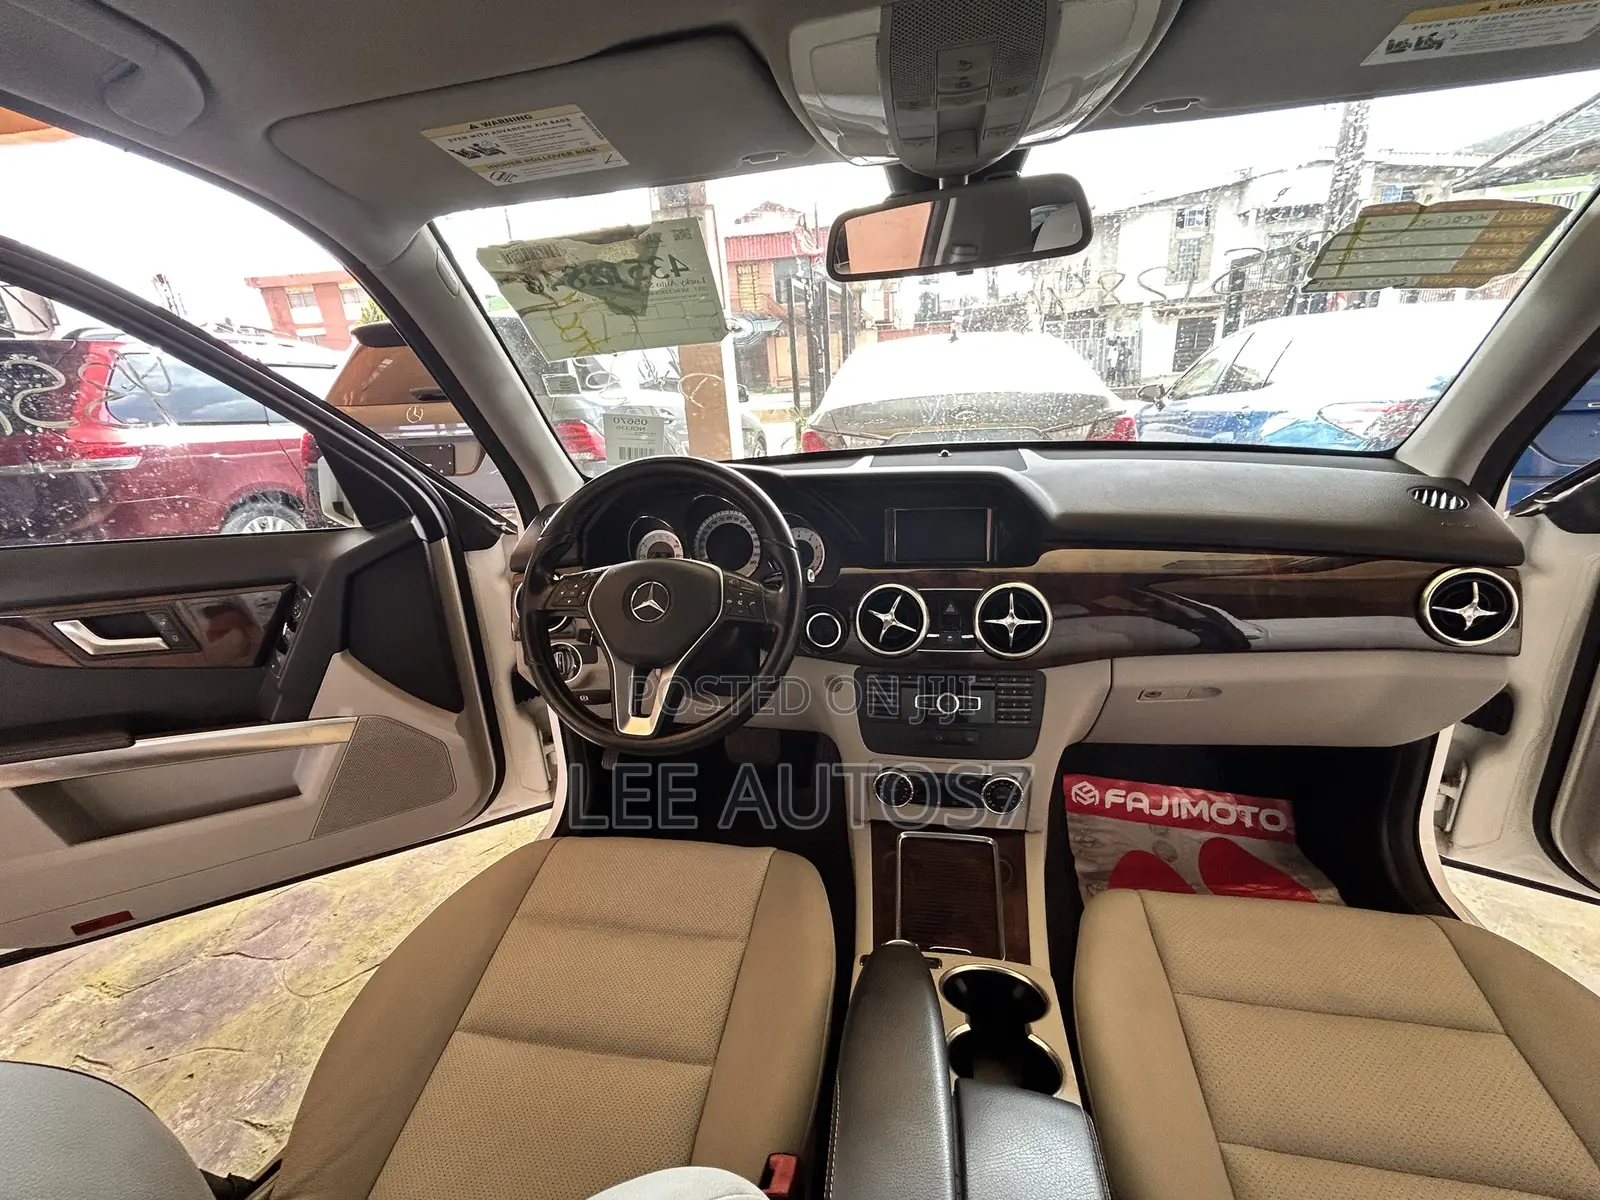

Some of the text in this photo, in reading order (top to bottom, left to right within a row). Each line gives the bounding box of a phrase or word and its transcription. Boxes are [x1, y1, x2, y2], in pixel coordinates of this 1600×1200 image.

[1447, 18, 1479, 26] WITH
[448, 117, 571, 143] EVEN WITH ADVANCED AIR BAGS
[480, 114, 533, 129] WARNING
[486, 158, 523, 171] HIGHER
[524, 149, 571, 165] ROLLOVER
[572, 146, 598, 156] RISK
[1104, 788, 1288, 833] FAJIMOTO
